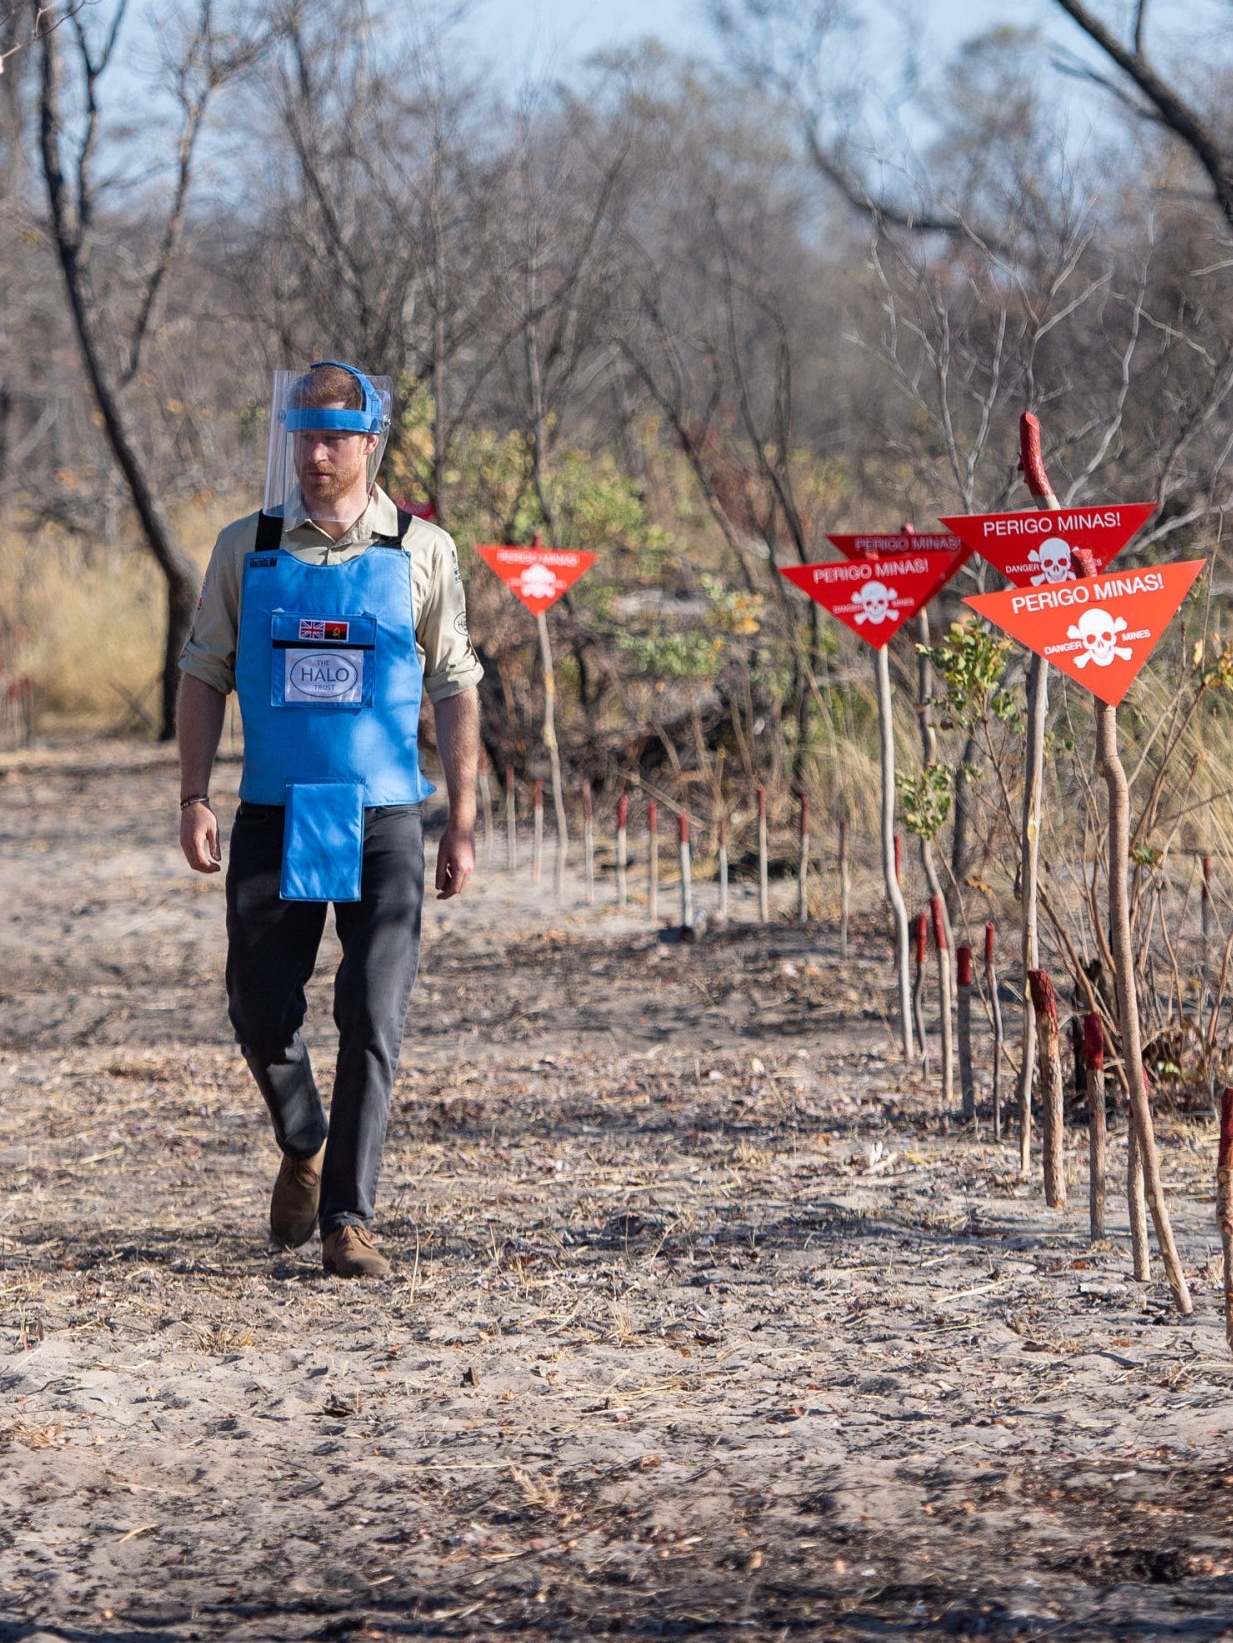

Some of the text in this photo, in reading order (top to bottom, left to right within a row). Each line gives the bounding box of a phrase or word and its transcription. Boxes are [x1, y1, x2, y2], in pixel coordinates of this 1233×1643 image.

[983, 511, 1121, 537] PERIGO MINAS!
[854, 536, 909, 551] PERIGO
[813, 557, 930, 584] PERIGO MINAS!
[1005, 564, 1040, 574] DANGER
[1011, 572, 1165, 614] PERIGO MINAS!
[1044, 629, 1152, 655] DANGER MINES
[301, 667, 349, 682] HALO
